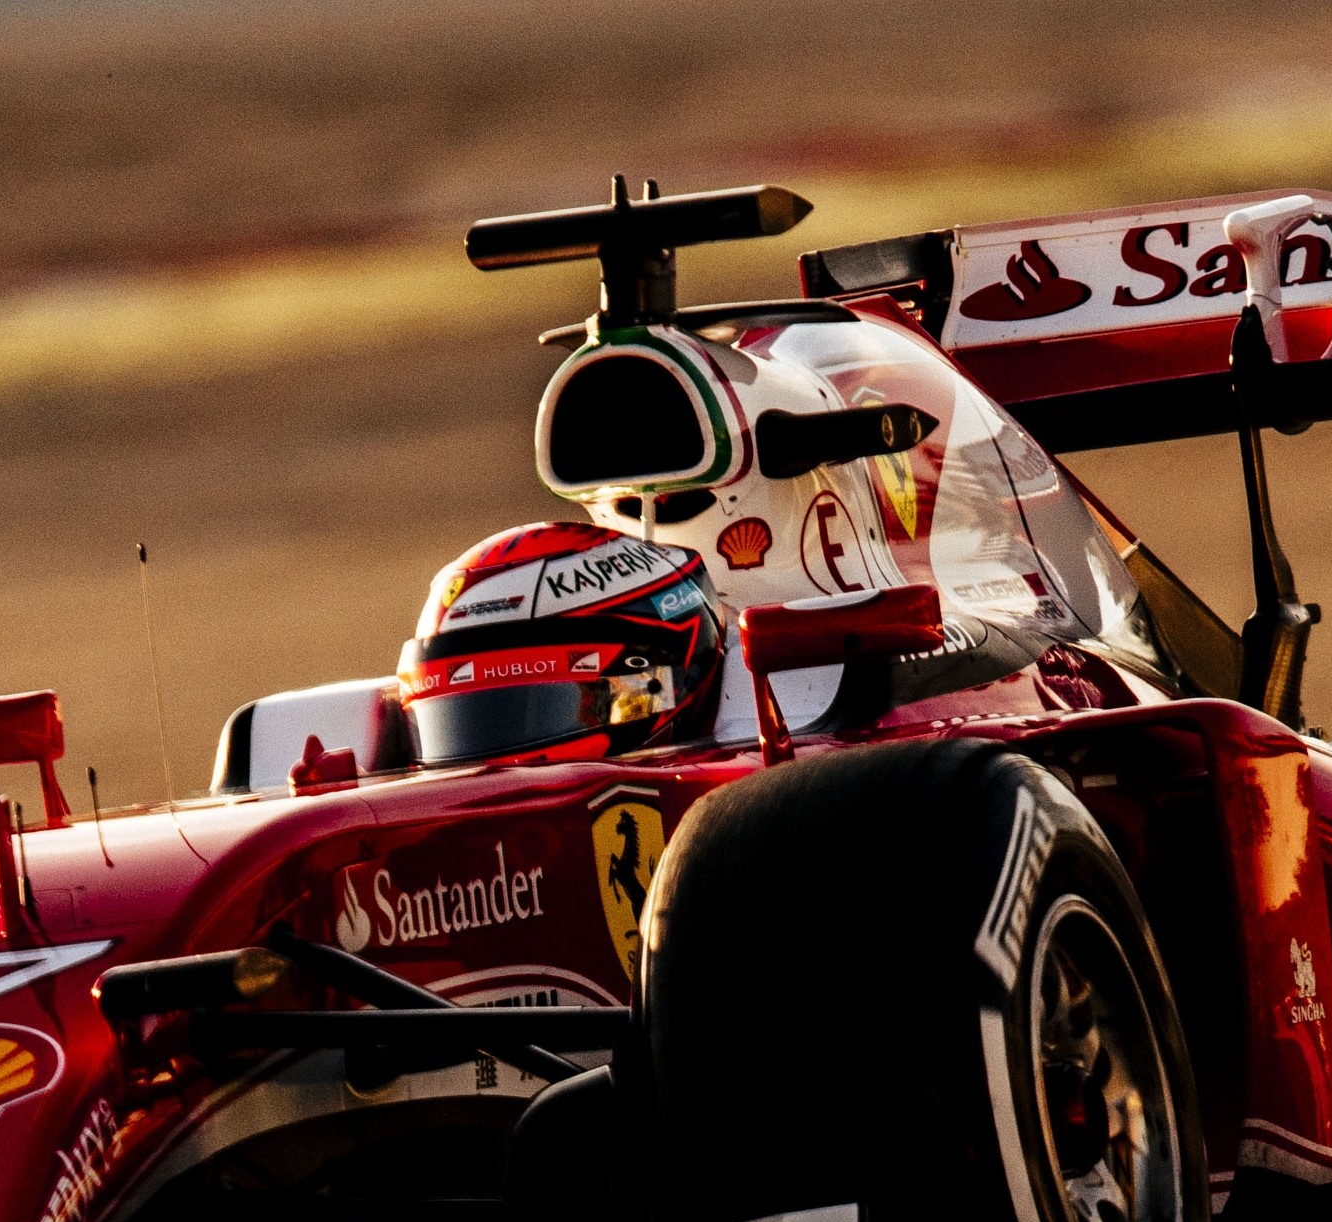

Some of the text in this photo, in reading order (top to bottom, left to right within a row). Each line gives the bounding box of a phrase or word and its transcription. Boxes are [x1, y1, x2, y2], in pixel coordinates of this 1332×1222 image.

[483, 660, 558, 679] HUBLOT
[373, 839, 544, 947] Santander
[1290, 1001, 1326, 1024] SINGHA
